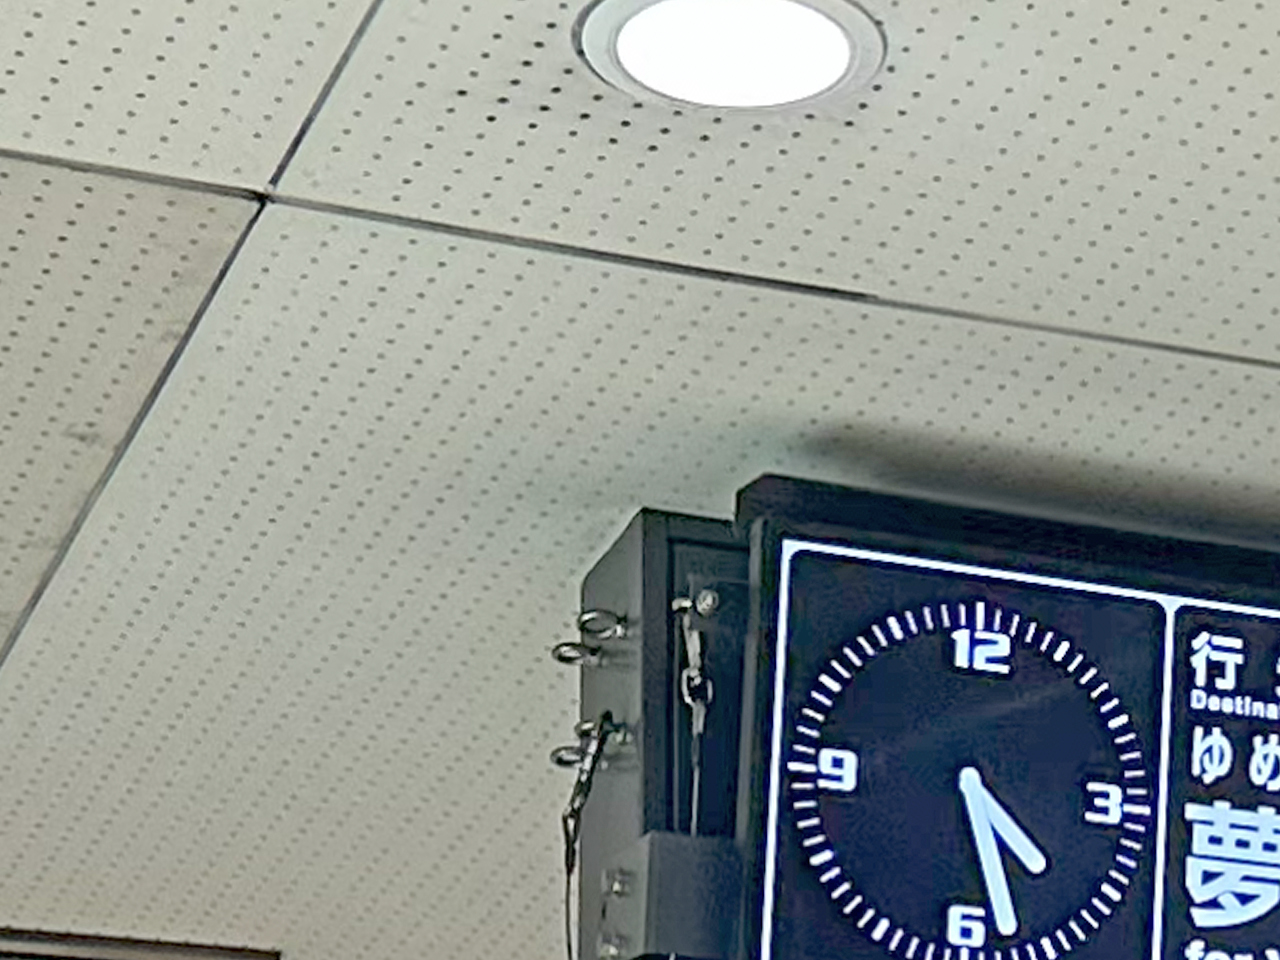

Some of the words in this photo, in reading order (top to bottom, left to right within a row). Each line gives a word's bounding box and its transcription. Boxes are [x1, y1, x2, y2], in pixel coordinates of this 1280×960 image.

[952, 629, 1010, 674] 12
[817, 748, 858, 792] 9
[1084, 781, 1123, 825] 3
[946, 904, 985, 948] 6
